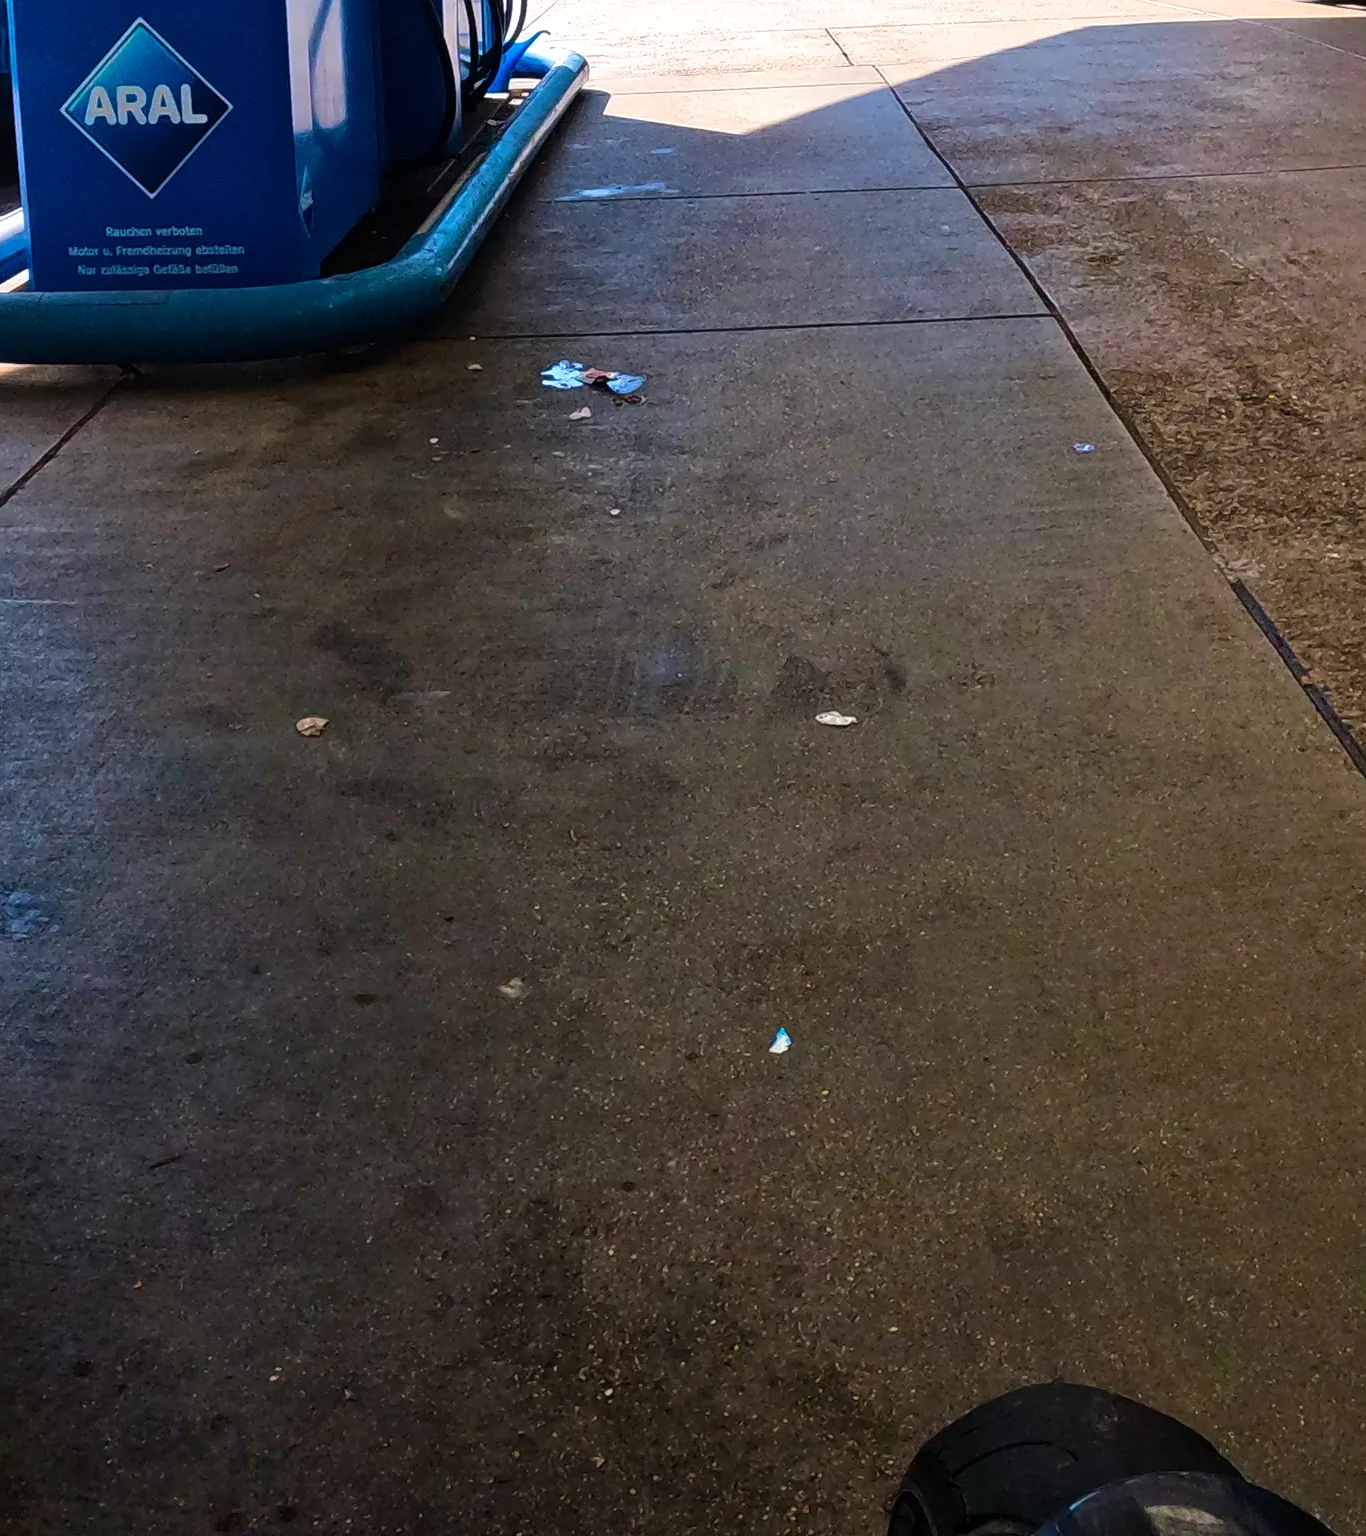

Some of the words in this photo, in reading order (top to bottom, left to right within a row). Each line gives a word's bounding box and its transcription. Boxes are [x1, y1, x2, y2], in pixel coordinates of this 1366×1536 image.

[85, 83, 208, 126] ARAL
[105, 226, 152, 237] Rauchen
[155, 225, 203, 236] verboten
[68, 246, 99, 256] Motor
